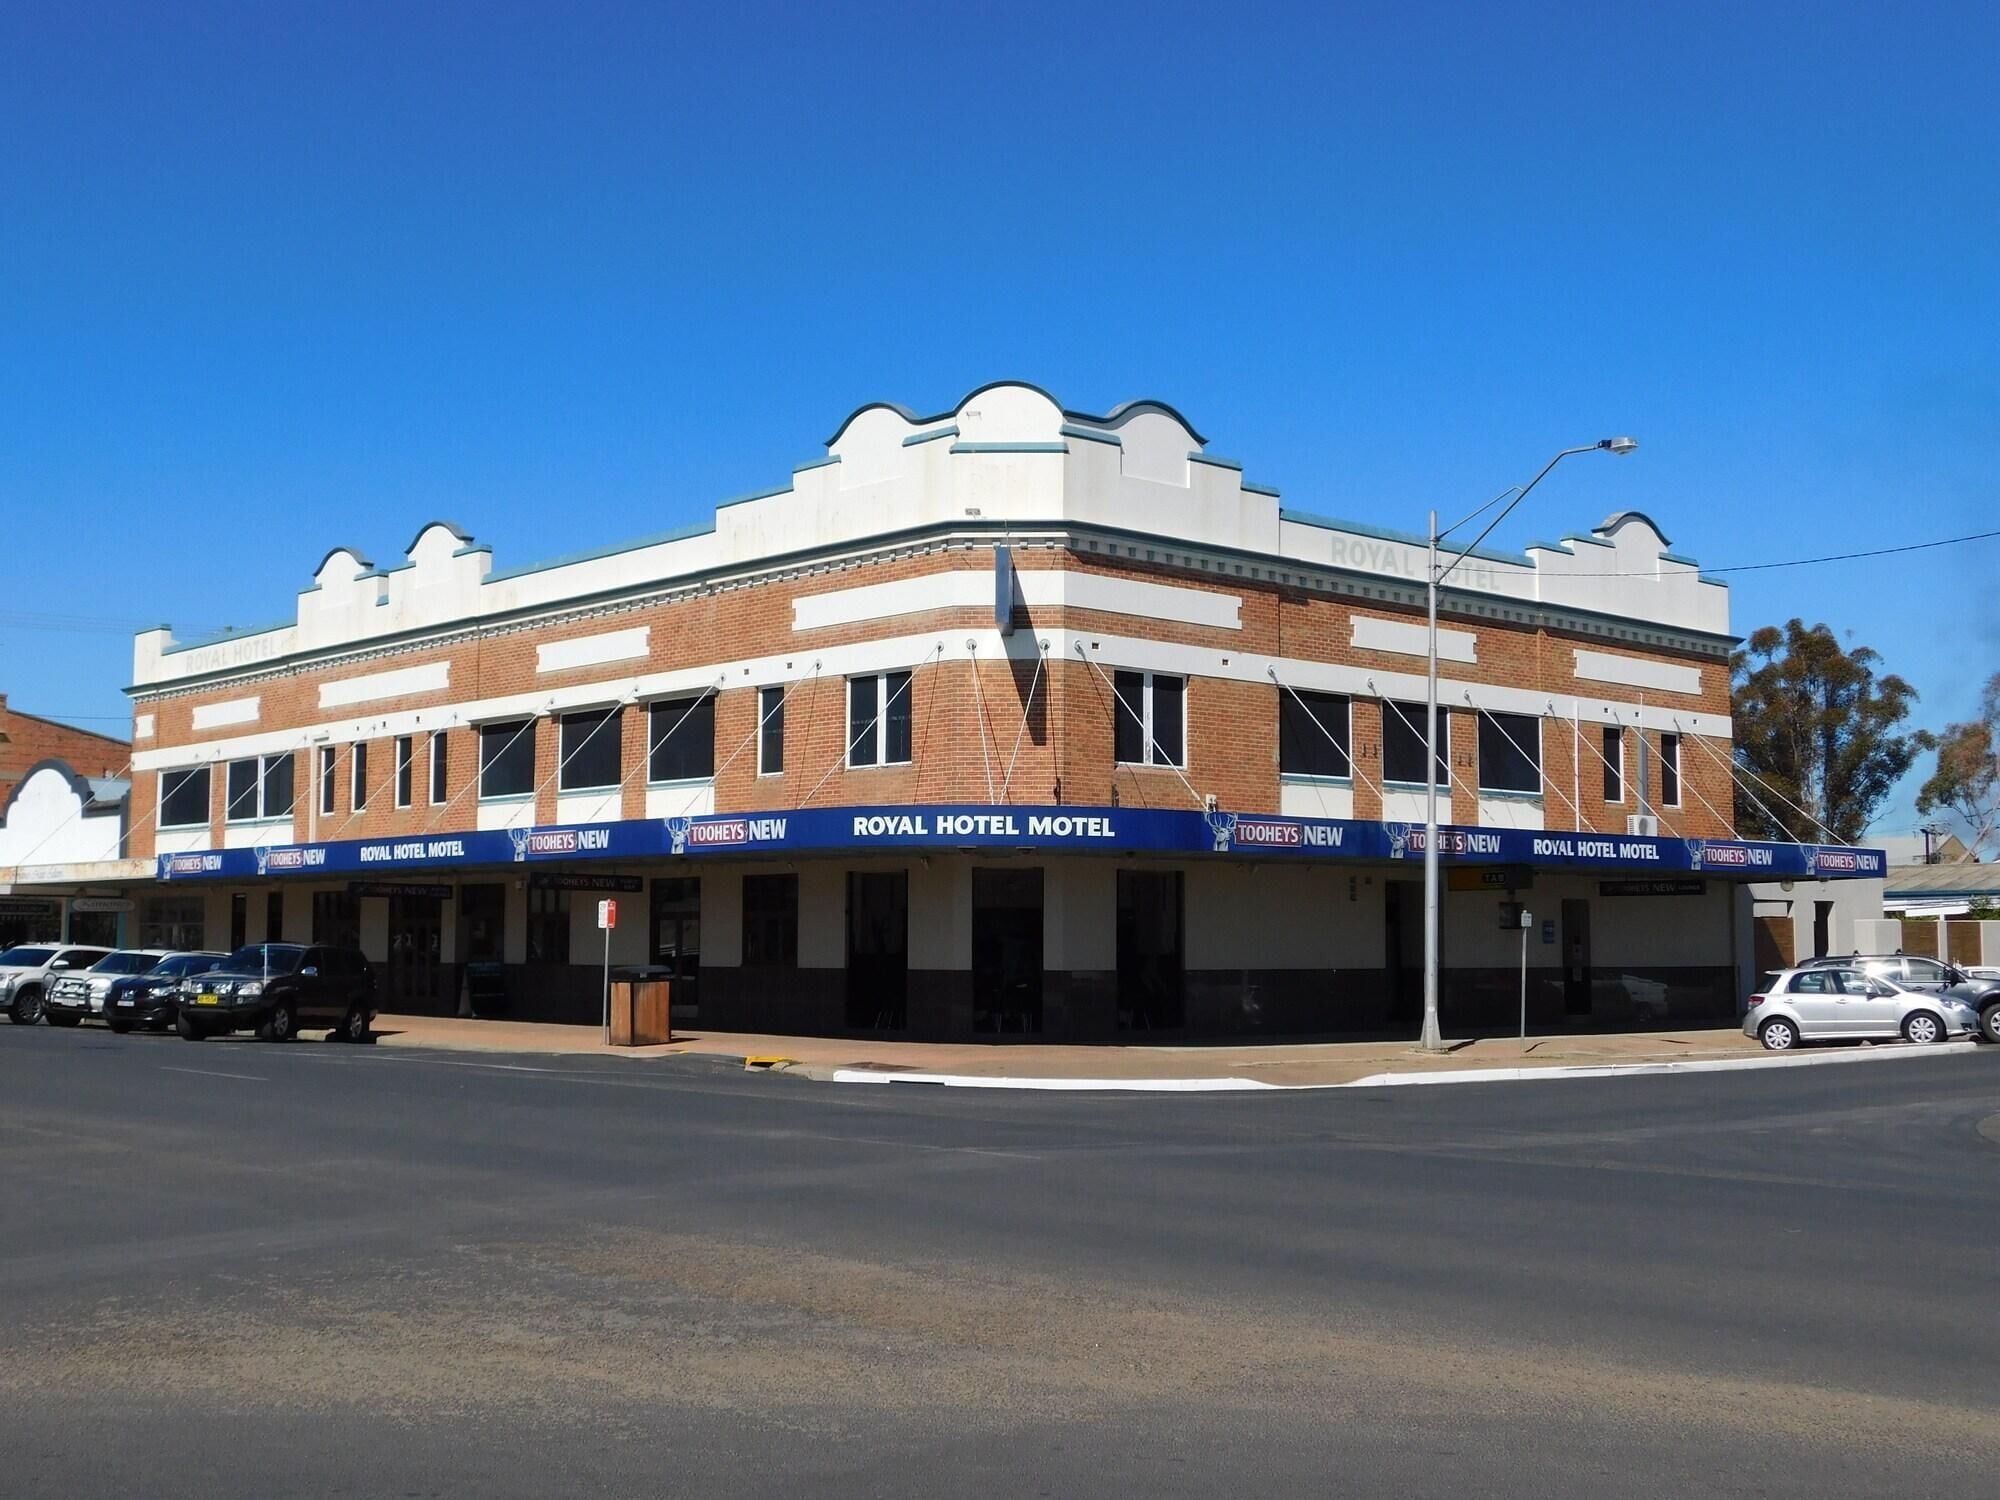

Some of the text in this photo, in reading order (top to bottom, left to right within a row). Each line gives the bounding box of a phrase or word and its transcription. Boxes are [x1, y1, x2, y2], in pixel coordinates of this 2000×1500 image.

[1331, 536, 1500, 590] ROYAL OTEL
[185, 637, 276, 673] ROYAL HOTEL
[691, 818, 787, 842] TOOHEYS NEW
[853, 815, 1115, 837] ROYAL HOTEL MOTEL
[1237, 824, 1343, 847] TOOHEYS NEW
[360, 840, 464, 862] ROYAL HOTEL MOTEL
[531, 829, 609, 851] TOOHEYS NEW
[1411, 833, 1501, 853] TOHEYS NEW
[1533, 838, 1660, 860] ROYAL HOTEL MOTEL
[173, 855, 222, 871] TOOHEYS NEW
[270, 848, 326, 867] TOOHEYS NEW
[1706, 848, 1773, 865] TOOHEYS NEW
[1819, 853, 1879, 870] TOOHEYS NEW
[591, 878, 616, 888] NEW
[1653, 883, 1674, 892] NEW
